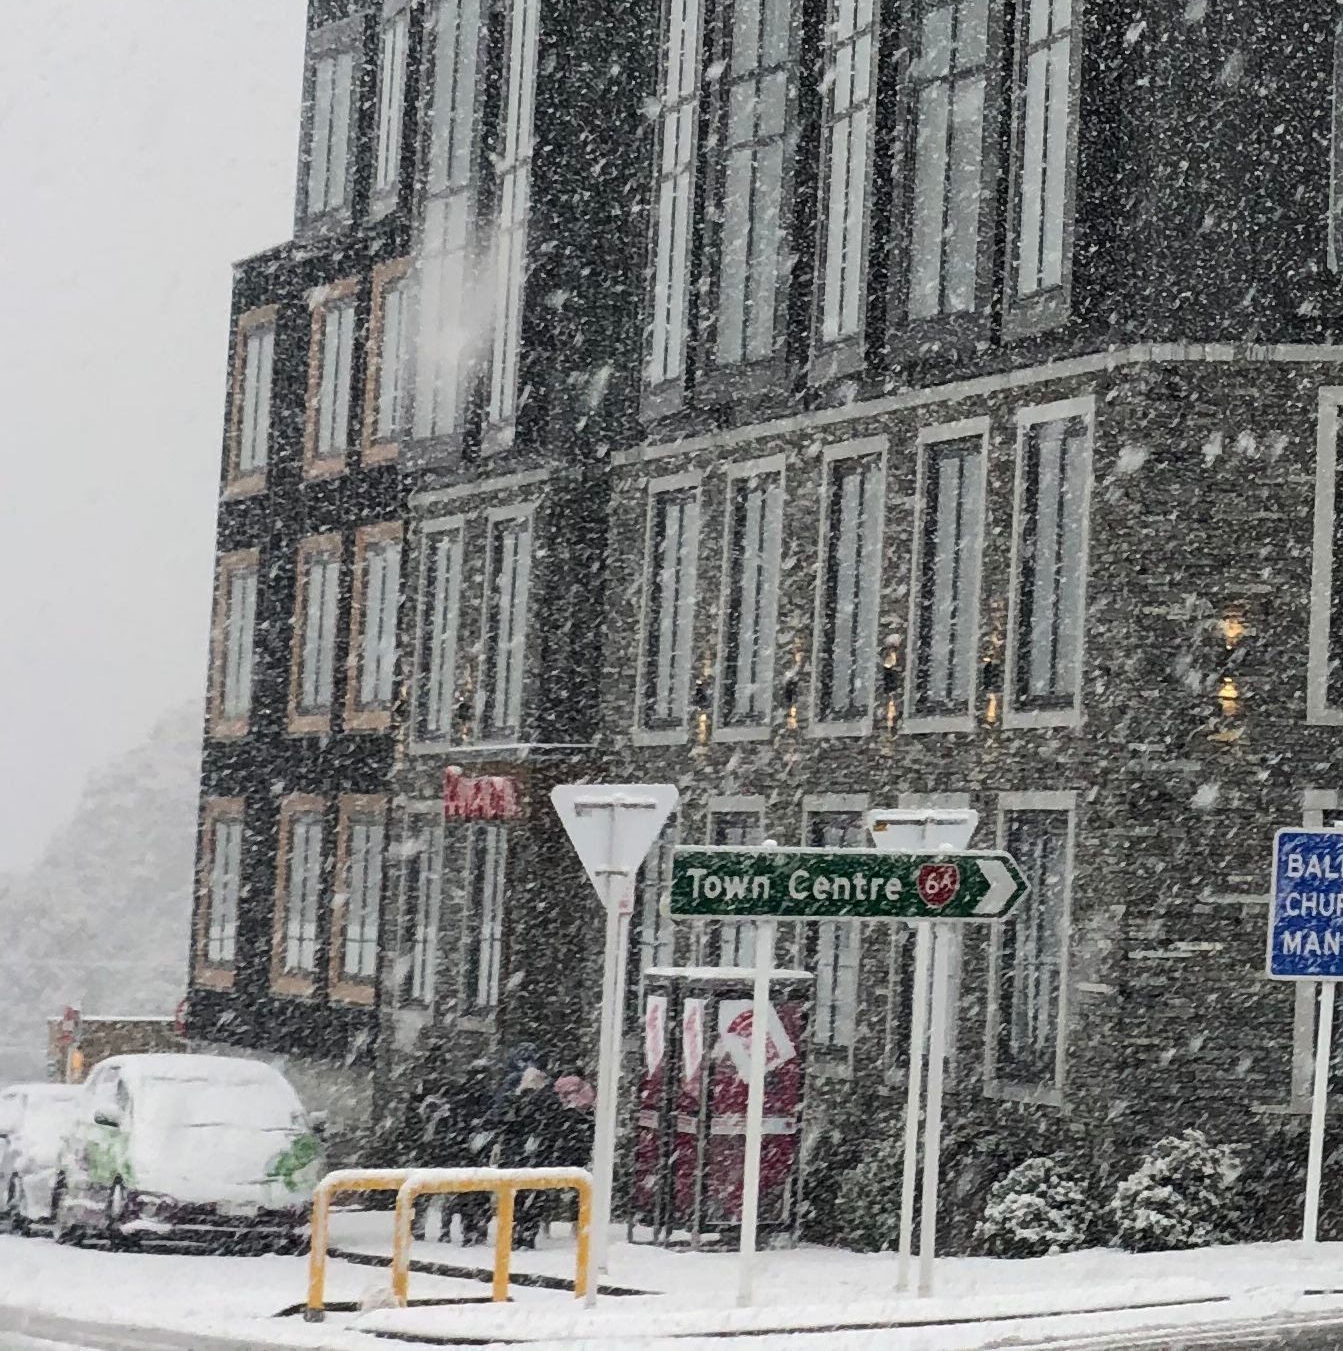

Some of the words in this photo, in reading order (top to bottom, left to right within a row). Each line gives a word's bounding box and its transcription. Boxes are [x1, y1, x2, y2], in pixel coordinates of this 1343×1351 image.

[687, 867, 771, 900] Town
[788, 868, 902, 902] Centre
[1281, 930, 1341, 956] MAN
